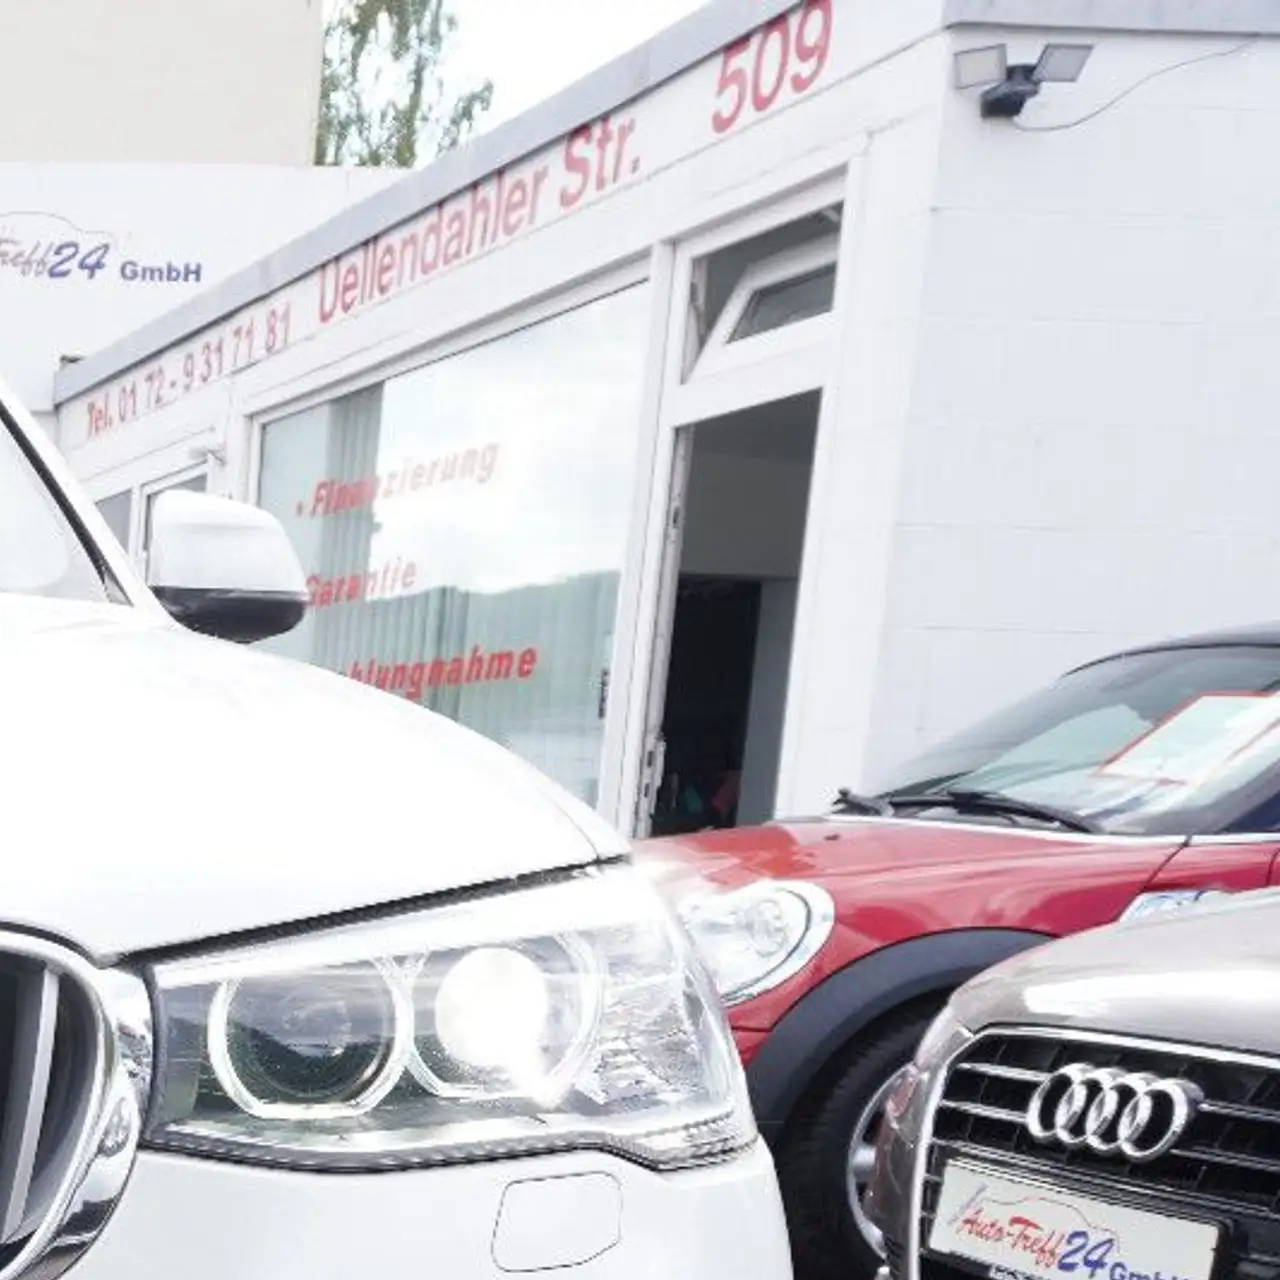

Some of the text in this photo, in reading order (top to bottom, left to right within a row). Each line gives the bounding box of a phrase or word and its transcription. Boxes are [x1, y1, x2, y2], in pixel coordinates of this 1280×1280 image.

[318, 0, 832, 324] Uellendahler Str. 509
[120, 259, 203, 283] GmbH
[86, 391, 113, 439] Tel.
